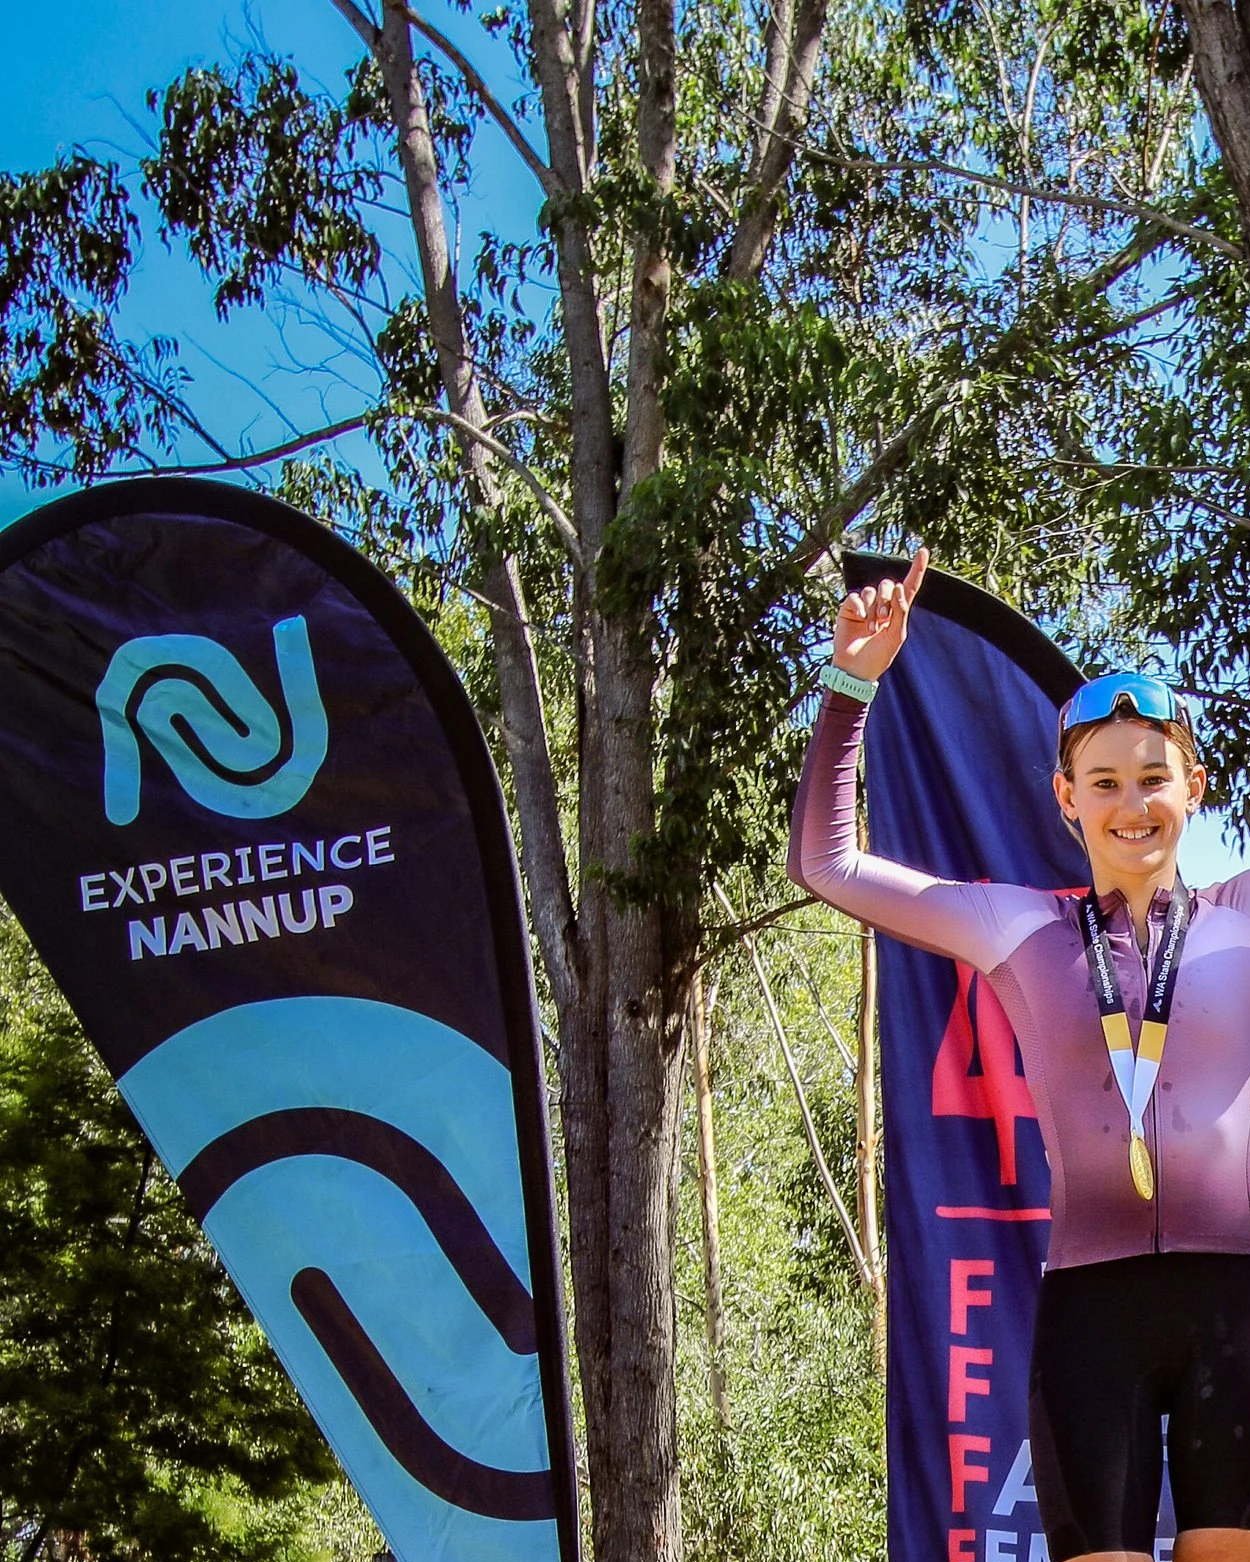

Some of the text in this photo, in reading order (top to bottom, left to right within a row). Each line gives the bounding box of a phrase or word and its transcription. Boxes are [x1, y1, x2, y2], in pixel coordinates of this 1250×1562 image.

[80, 826, 395, 912] EXPERIENCE
[128, 885, 354, 961] NANNUP
[1086, 911, 1114, 1005] WA State Championships
[1154, 904, 1184, 998] WA State Championships
